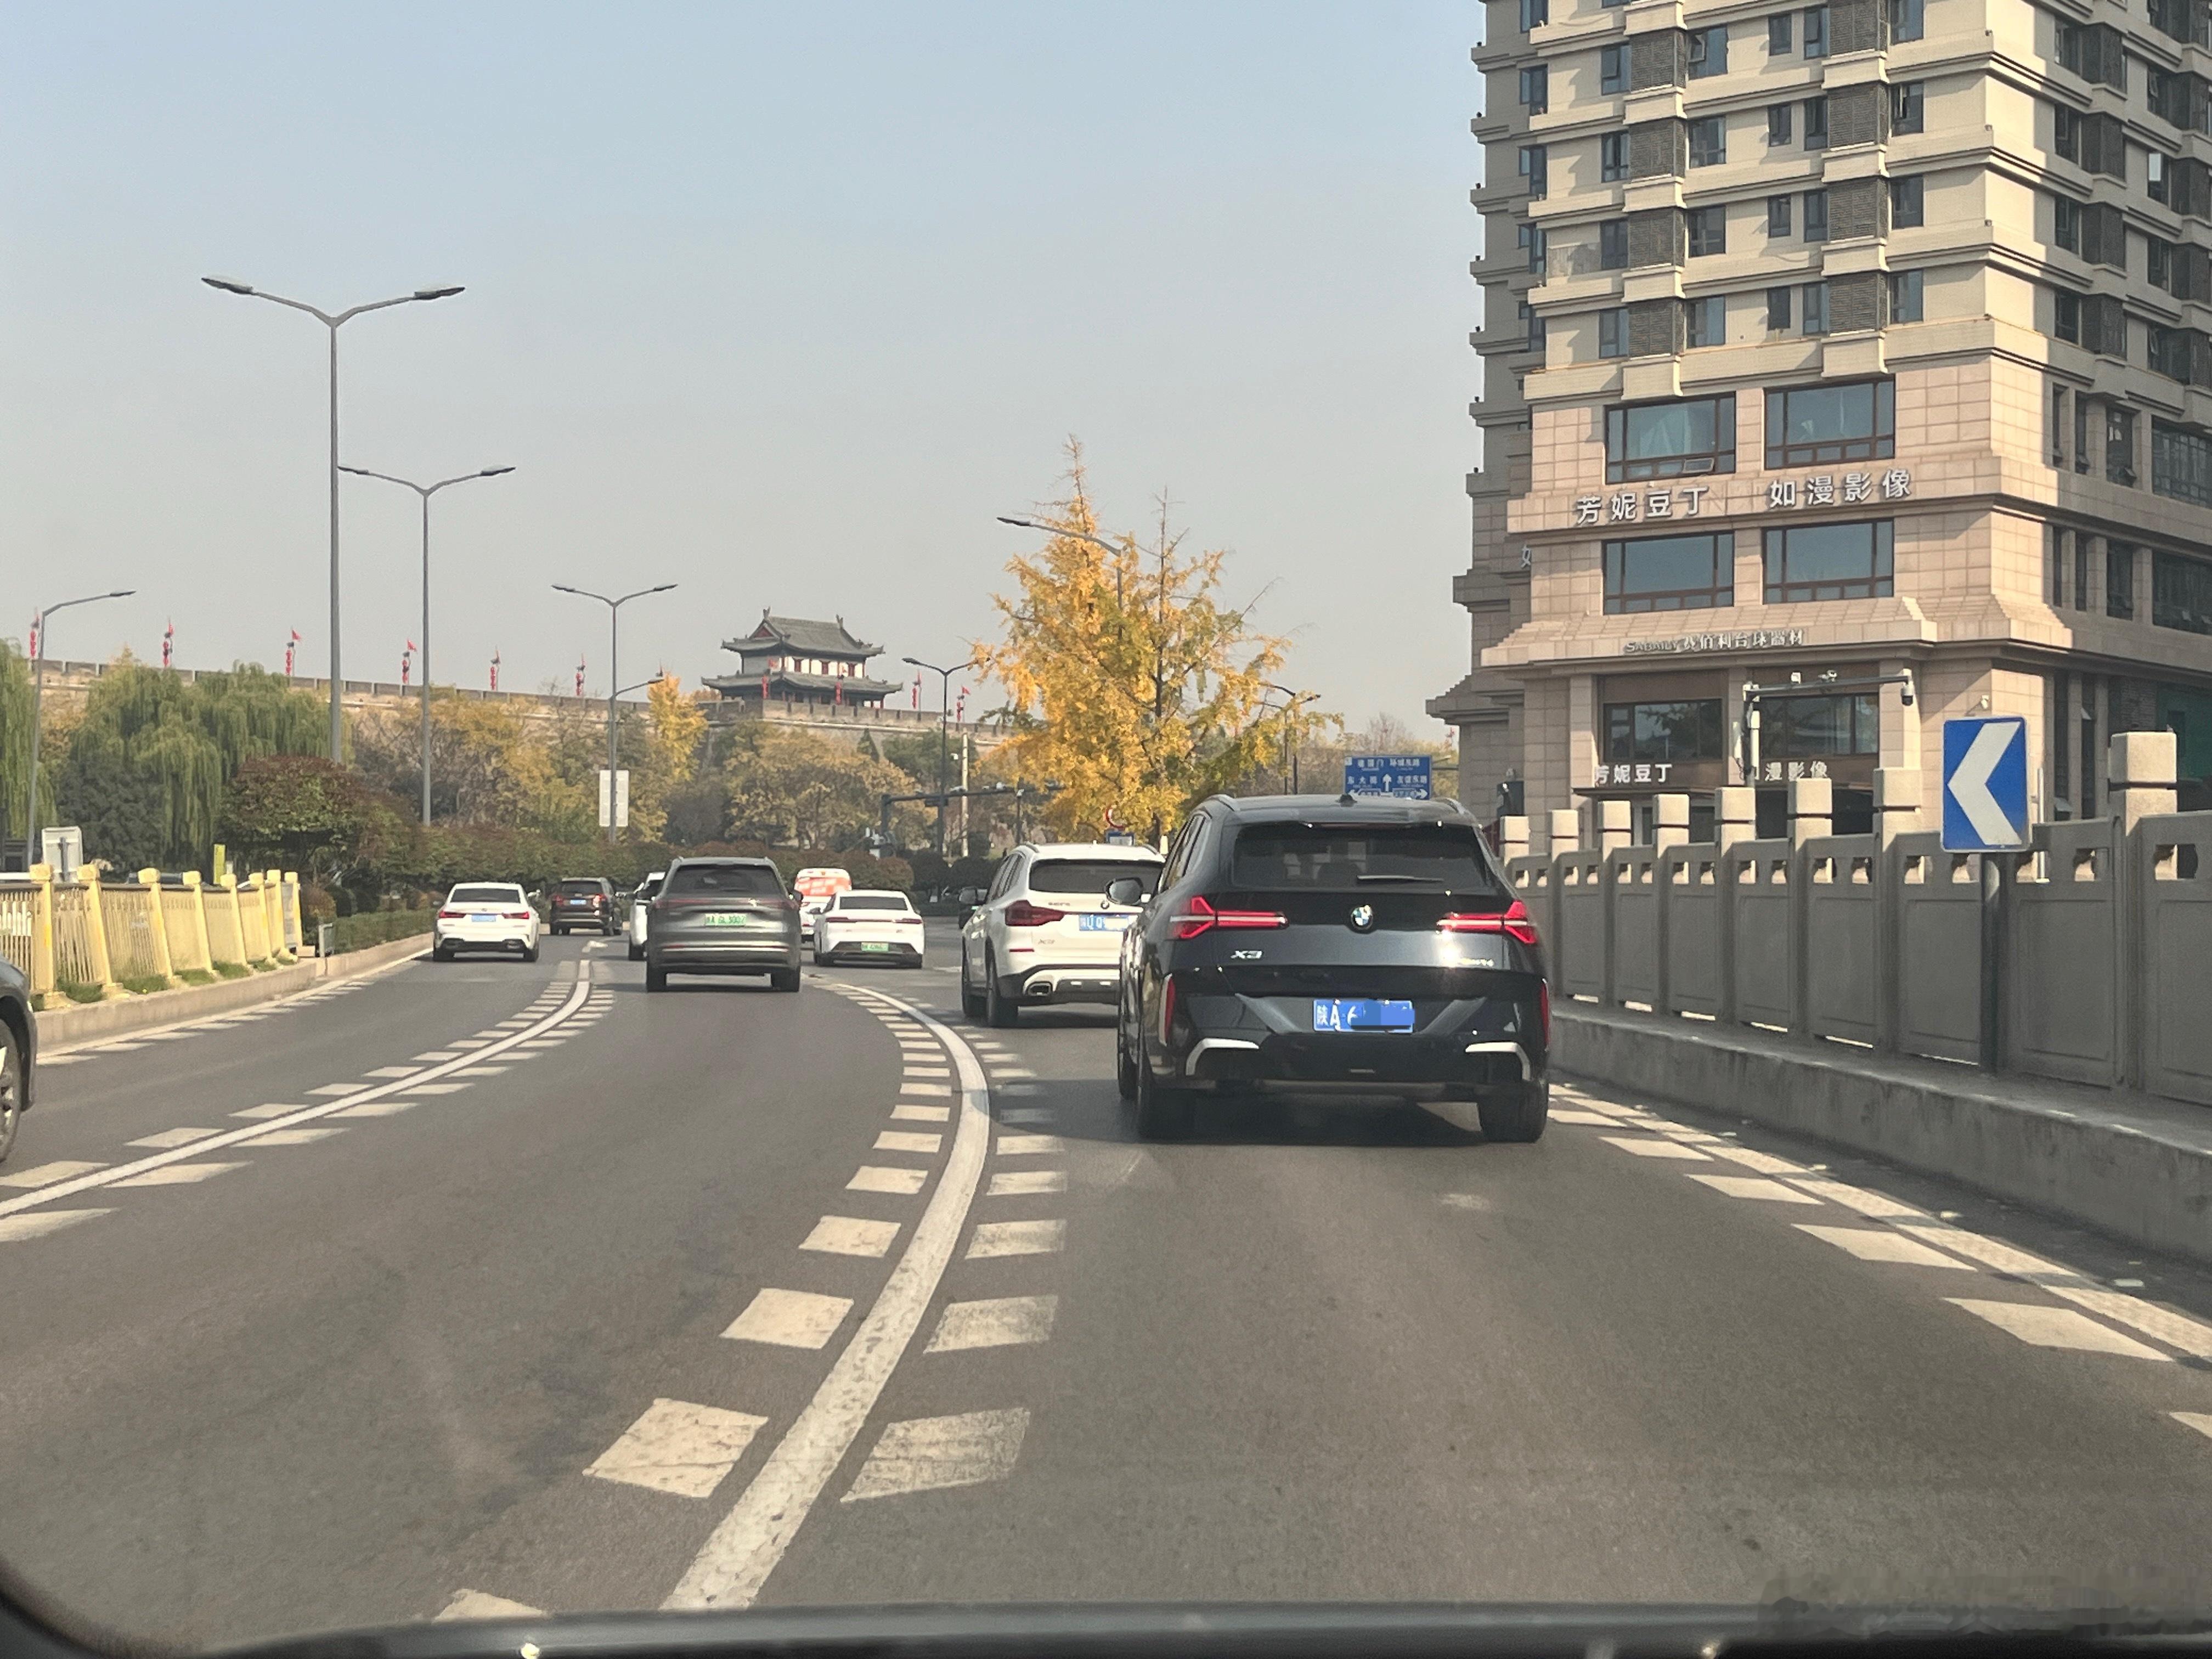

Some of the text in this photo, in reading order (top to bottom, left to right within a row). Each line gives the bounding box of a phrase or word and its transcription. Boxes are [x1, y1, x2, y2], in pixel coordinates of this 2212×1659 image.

[1576, 469, 1912, 524] 芳妮豆丁 如漫影像
[1764, 761, 1828, 781] 漫影像
[1230, 950, 1263, 959] X3
